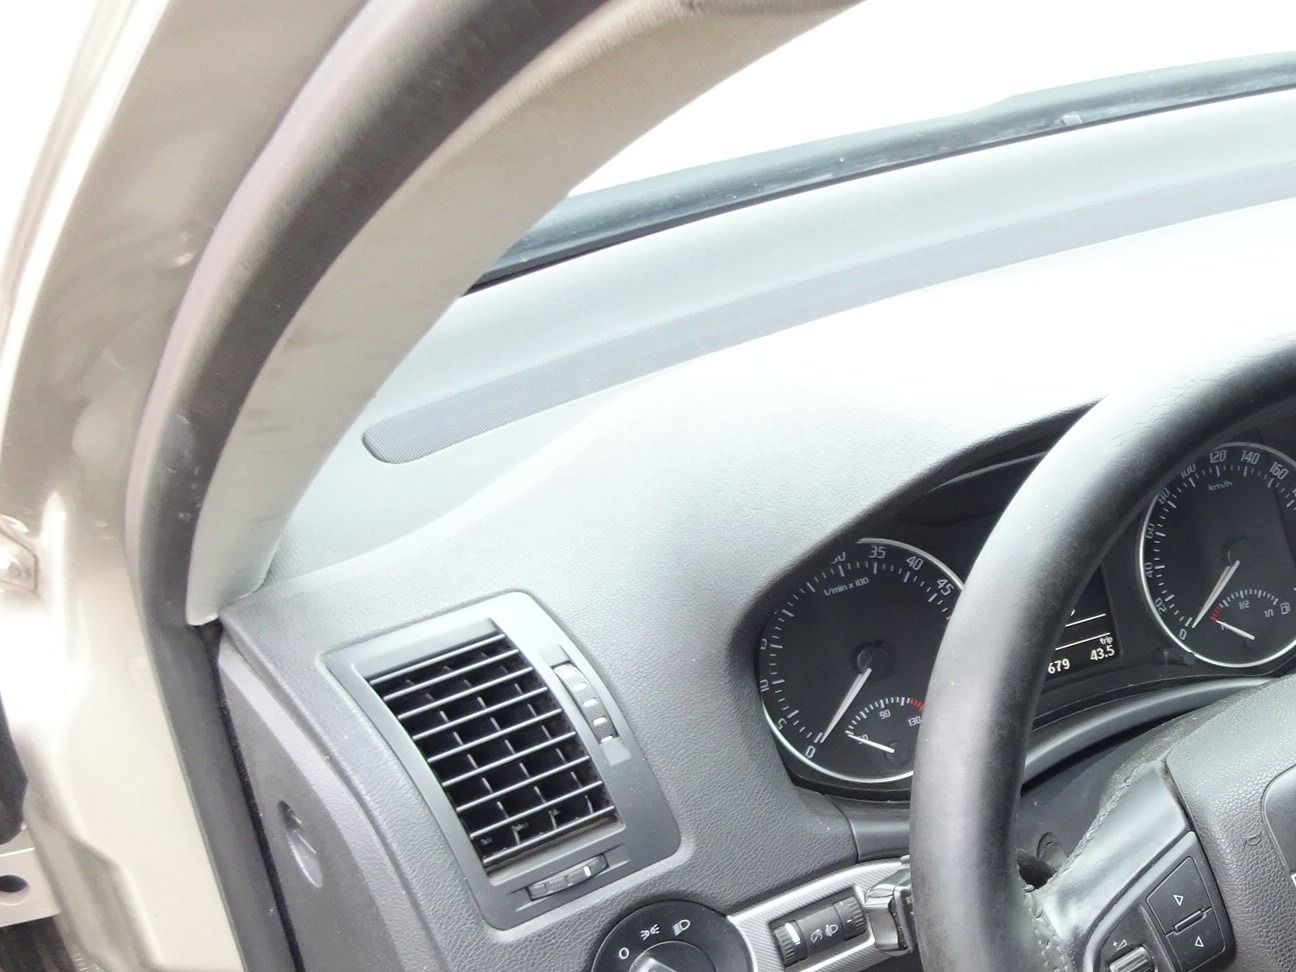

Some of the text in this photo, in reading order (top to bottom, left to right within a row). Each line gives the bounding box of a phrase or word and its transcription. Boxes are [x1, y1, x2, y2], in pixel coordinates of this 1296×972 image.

[1209, 449, 1227, 464] 120
[1240, 450, 1260, 465] 140
[1269, 461, 1289, 480] 160
[868, 545, 887, 559] 35
[906, 556, 924, 571] 40
[937, 577, 956, 597] 45
[1099, 635, 1114, 645] trip
[1178, 628, 1188, 641] 0
[1047, 644, 1116, 675] 679 43.5
[879, 708, 892, 720] 90
[907, 715, 922, 728] 130
[804, 744, 816, 760] 0
